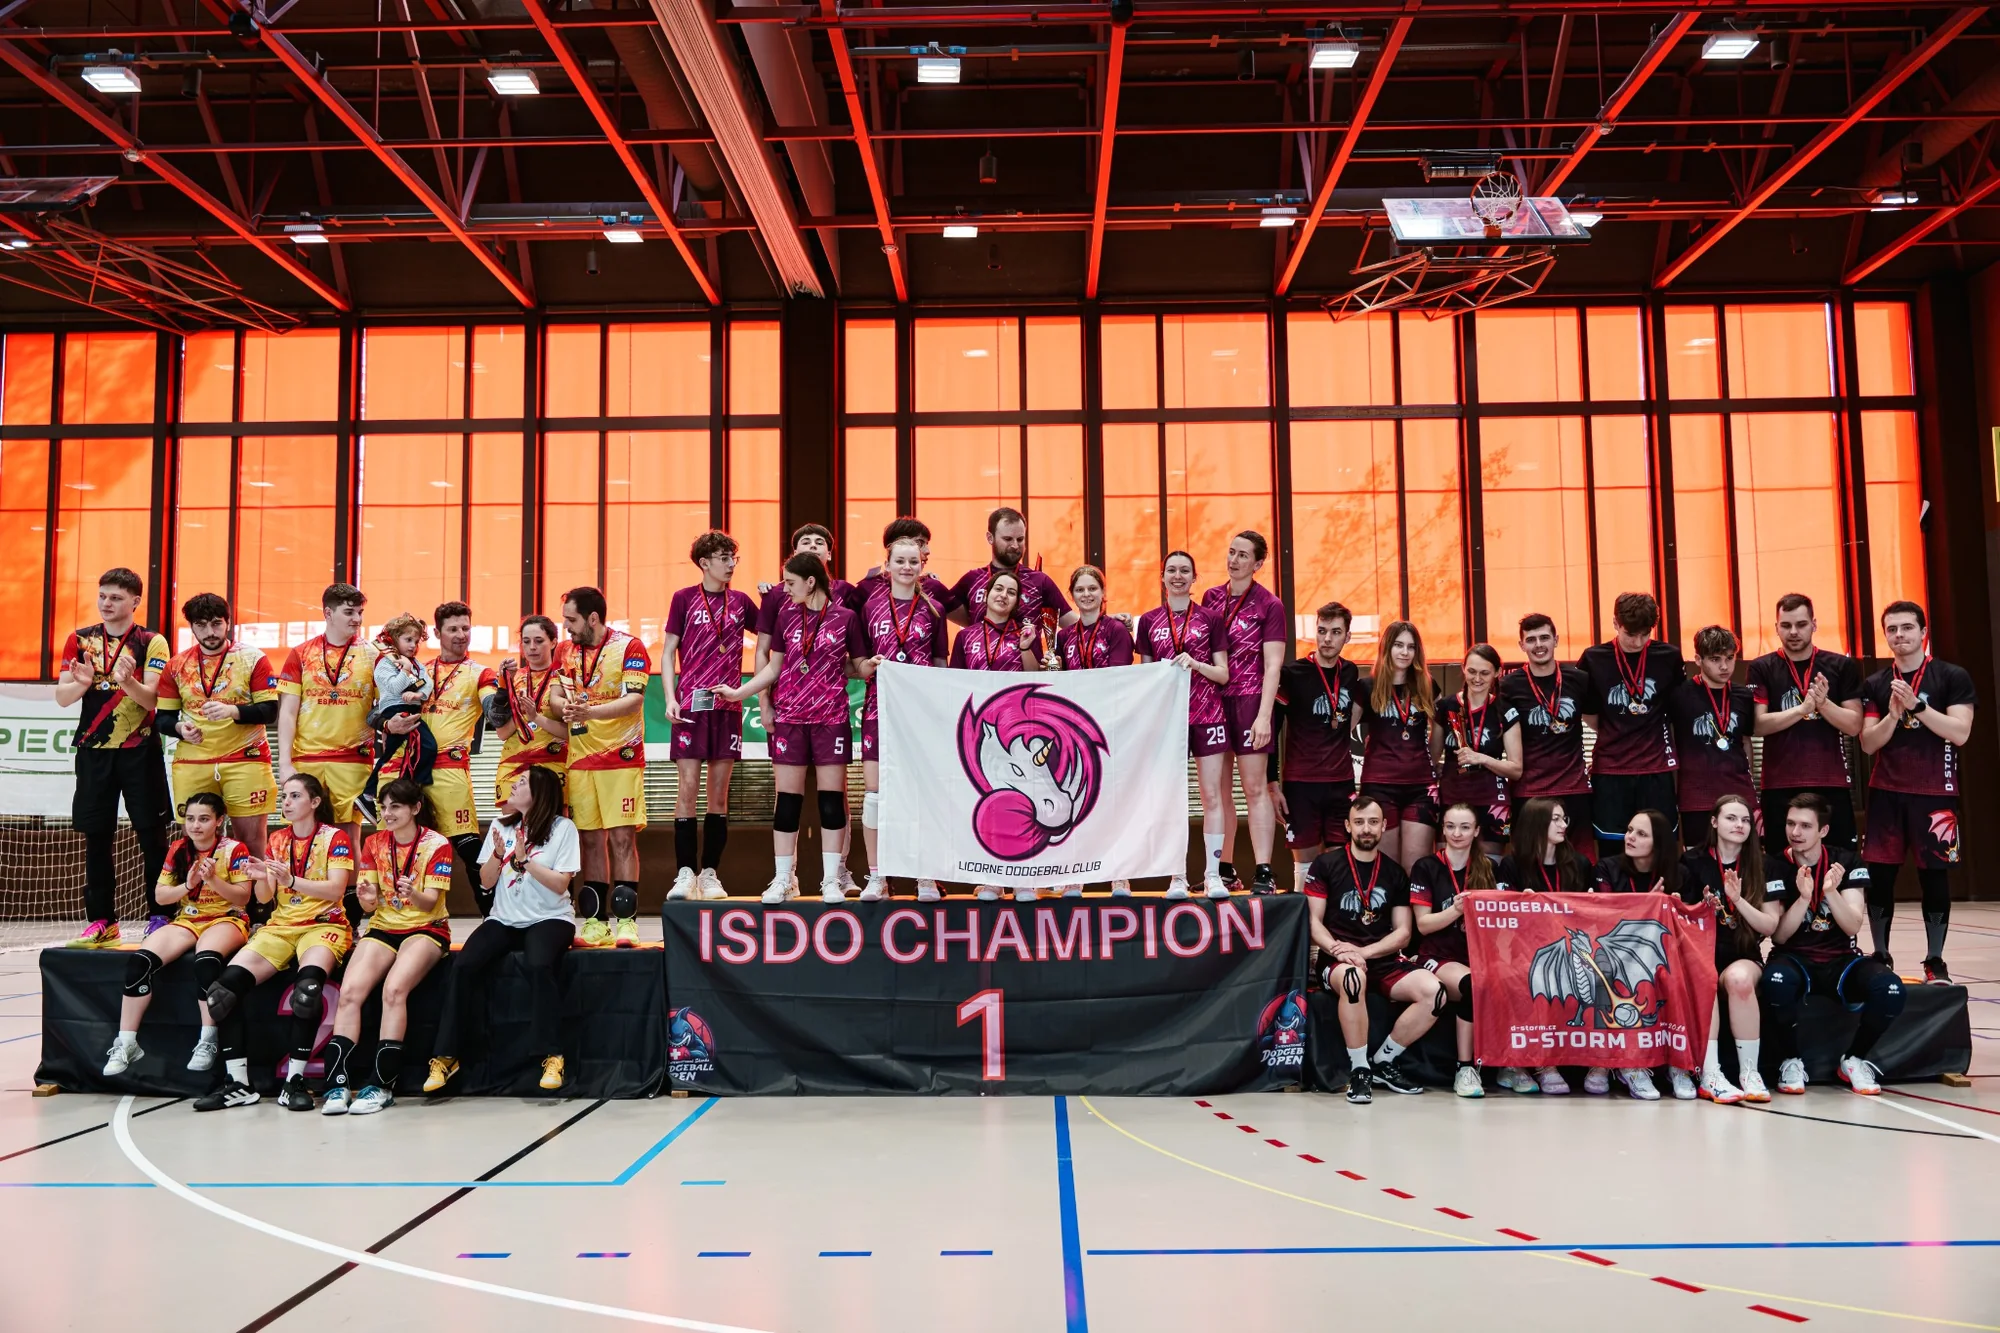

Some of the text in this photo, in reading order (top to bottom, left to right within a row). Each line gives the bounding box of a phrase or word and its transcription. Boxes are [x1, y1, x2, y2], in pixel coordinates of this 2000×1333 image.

[792, 629, 803, 643] 5
[872, 619, 891, 639] 15
[1153, 627, 1171, 642] 29
[1206, 725, 1227, 746] 29
[834, 736, 845, 755] 5
[249, 789, 268, 805] 23
[621, 797, 635, 813] 21
[455, 809, 470, 824] 93
[958, 860, 1102, 877] LICORNE DODGEBALL CLUB
[1475, 900, 1574, 914] DODGEBALL
[1477, 917, 1519, 929] CLUB
[700, 899, 1265, 965] ISDO CHAMPION
[956, 988, 1005, 1081] 1
[1510, 1024, 1557, 1032] d-storm.cz
[1510, 1031, 1687, 1051] D-STORM BRNO
[1267, 1055, 1304, 1067] OPEN
